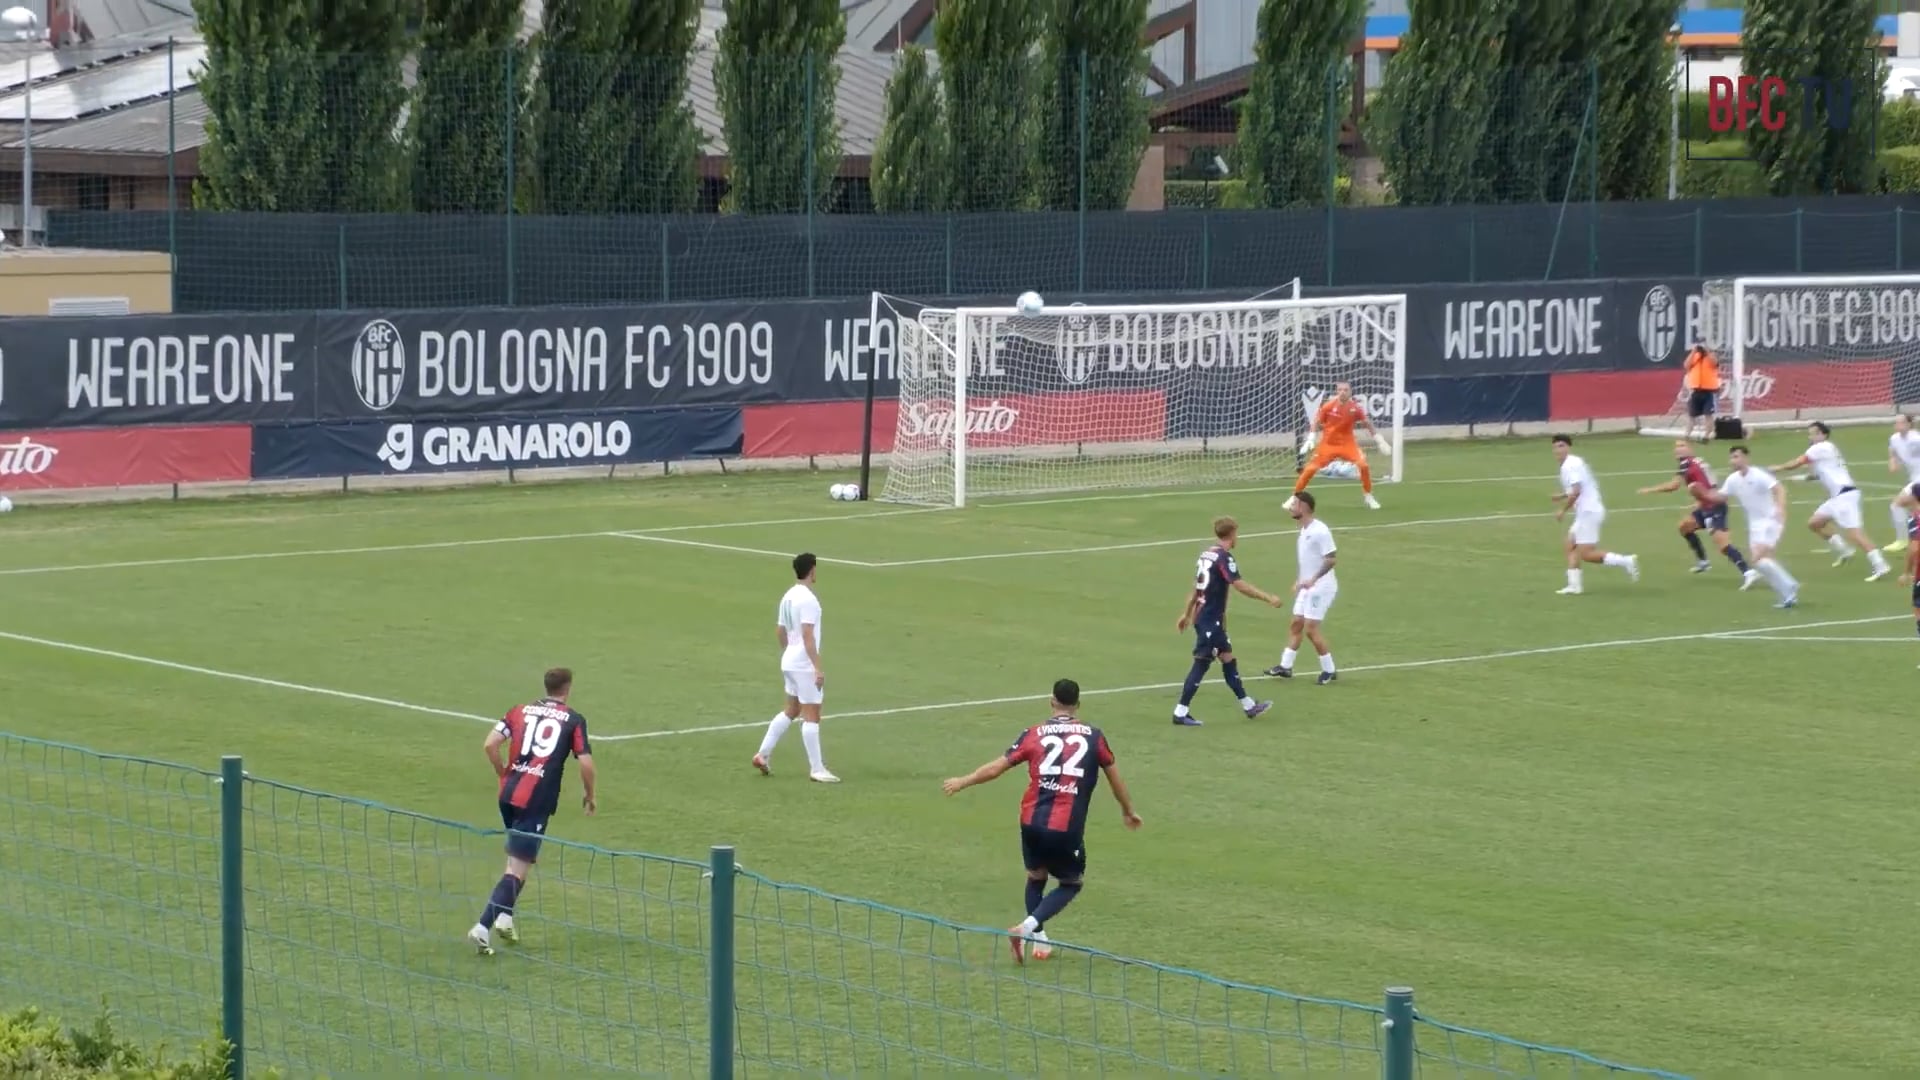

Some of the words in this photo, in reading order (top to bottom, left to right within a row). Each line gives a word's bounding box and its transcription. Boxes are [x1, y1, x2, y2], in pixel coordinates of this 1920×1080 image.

[368, 325, 391, 343] BFC
[1107, 311, 1263, 372] BOLOGNA
[1328, 304, 1396, 364] 1909
[1444, 296, 1603, 360] WEAREONE
[1828, 290, 1860, 345] FC
[1869, 288, 1920, 344] 190
[68, 333, 295, 409] WEAREONE
[419, 326, 607, 397] BOLOGNA
[625, 324, 671, 390] FC
[684, 321, 772, 387] 1909
[824, 315, 1007, 381] WEAREONE
[423, 420, 632, 466] GRANAROLO
[901, 401, 1019, 446] Saputo
[520, 715, 561, 758] 19
[1039, 735, 1088, 777] 22
